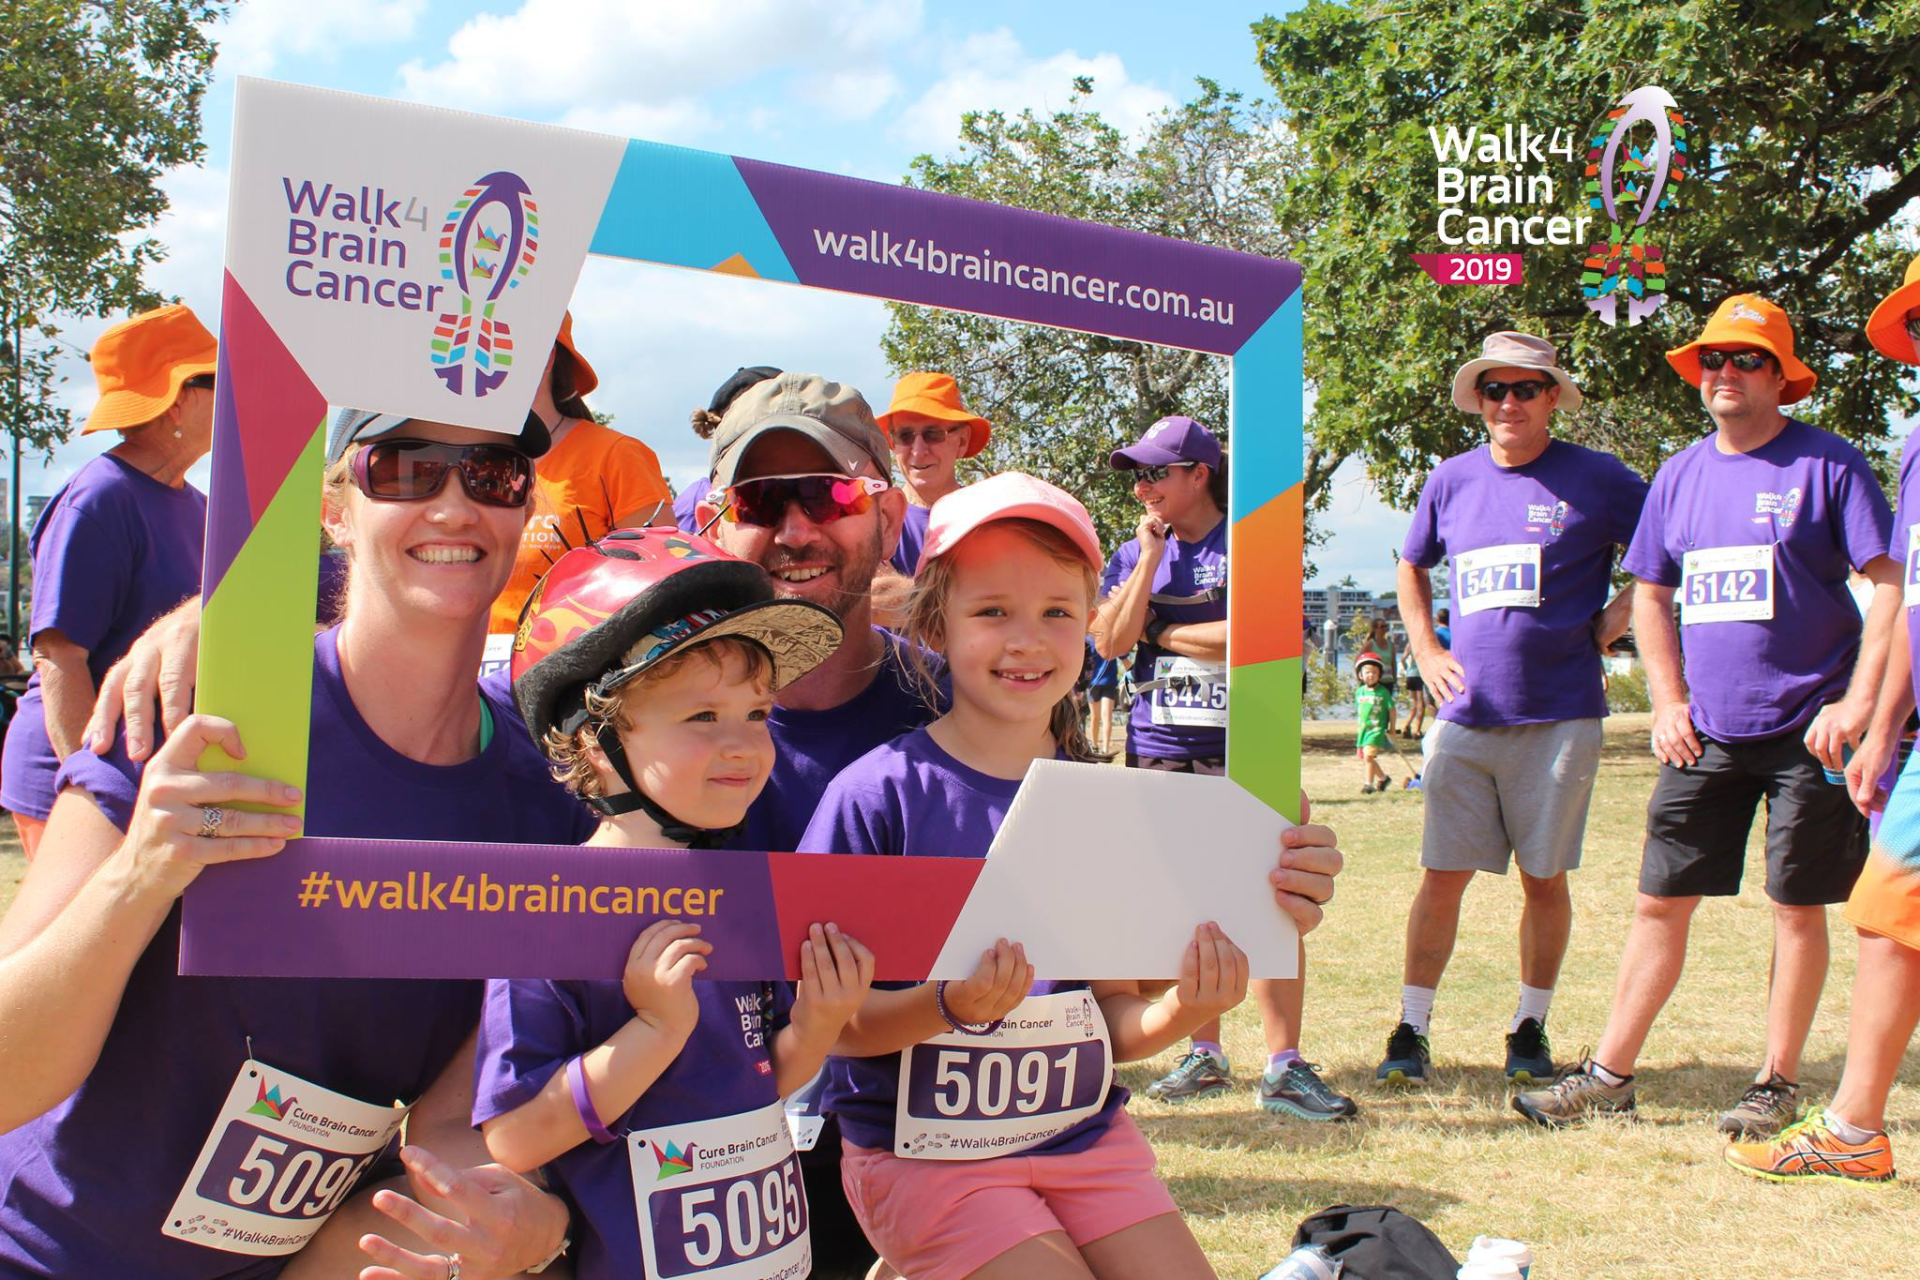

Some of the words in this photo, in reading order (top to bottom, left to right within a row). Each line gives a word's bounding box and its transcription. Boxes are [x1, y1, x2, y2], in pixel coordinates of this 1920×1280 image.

[282, 177, 428, 231] Walk4
[288, 218, 406, 269] Brain
[285, 260, 444, 312] Cancer
[813, 228, 1234, 326] walk4braincancer.com.au
[1467, 565, 1523, 595] 5471
[1691, 571, 1757, 604] 5142
[298, 871, 724, 915] #walk4braincancer
[1020, 1020, 1054, 1029] Cancer
[934, 1047, 1078, 1116] 5091
[288, 1119, 331, 1139] FOUNDATION
[293, 1107, 319, 1125] Cure
[319, 1117, 347, 1133] Brain
[347, 1125, 377, 1138] Cancer
[949, 1128, 1058, 1149] #Walk4BrainCancer
[699, 1147, 725, 1160] Cure
[727, 1140, 755, 1155] Brain
[755, 1132, 779, 1148] Cancer
[700, 1155, 745, 1170] FOUNDATION
[680, 1161, 801, 1267] 5095
